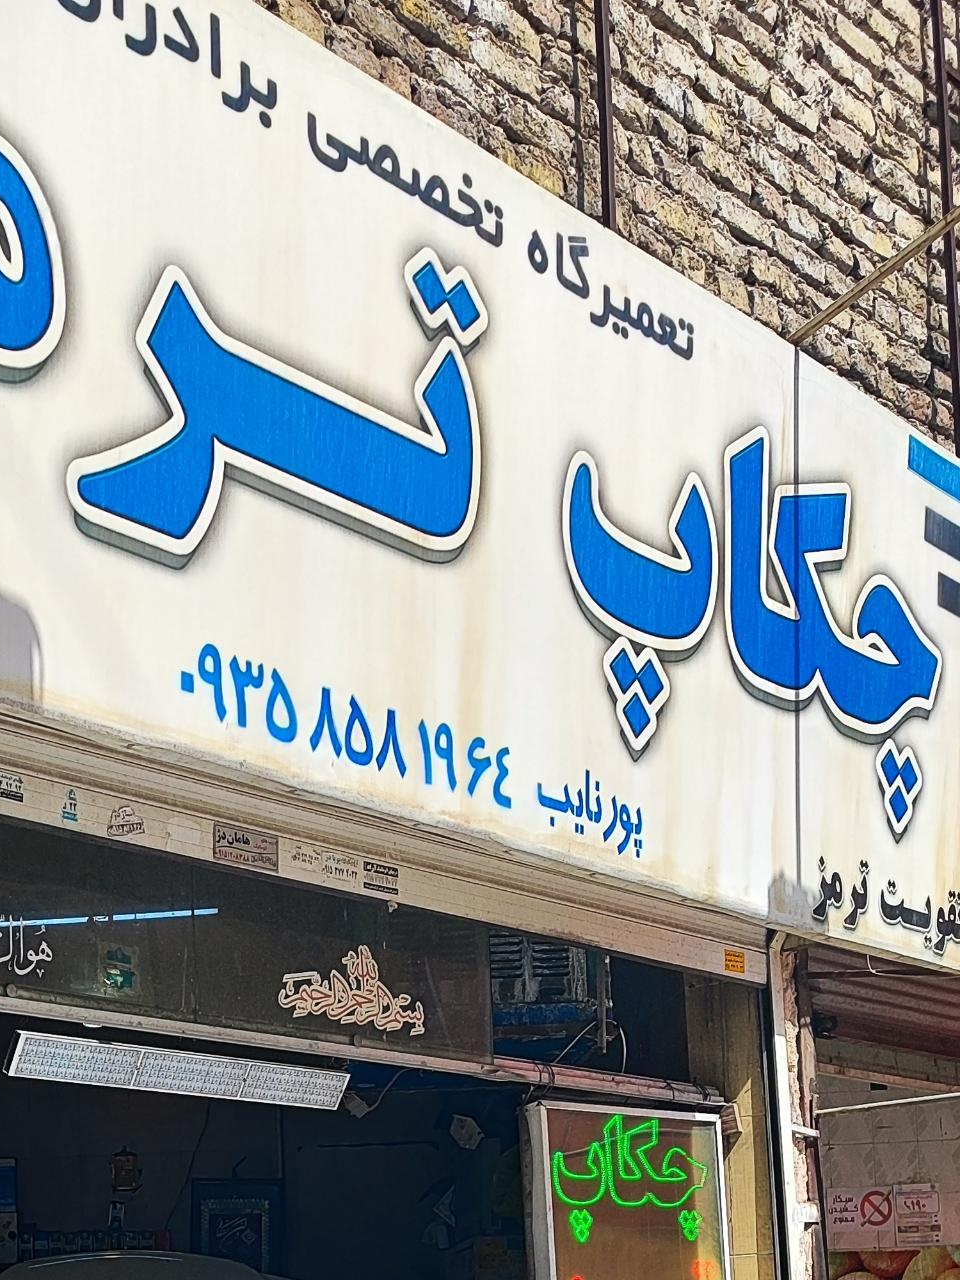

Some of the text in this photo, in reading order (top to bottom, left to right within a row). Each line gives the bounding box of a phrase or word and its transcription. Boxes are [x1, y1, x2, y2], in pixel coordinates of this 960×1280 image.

[306, 111, 504, 248] تخصصی
[526, 229, 695, 361] تعمیرگاه
[562, 425, 942, 836] چکاپ
[309, 685, 408, 780] ۸۵۸
[812, 855, 870, 930] ترمز
[552, 1114, 708, 1243] چکاپ
